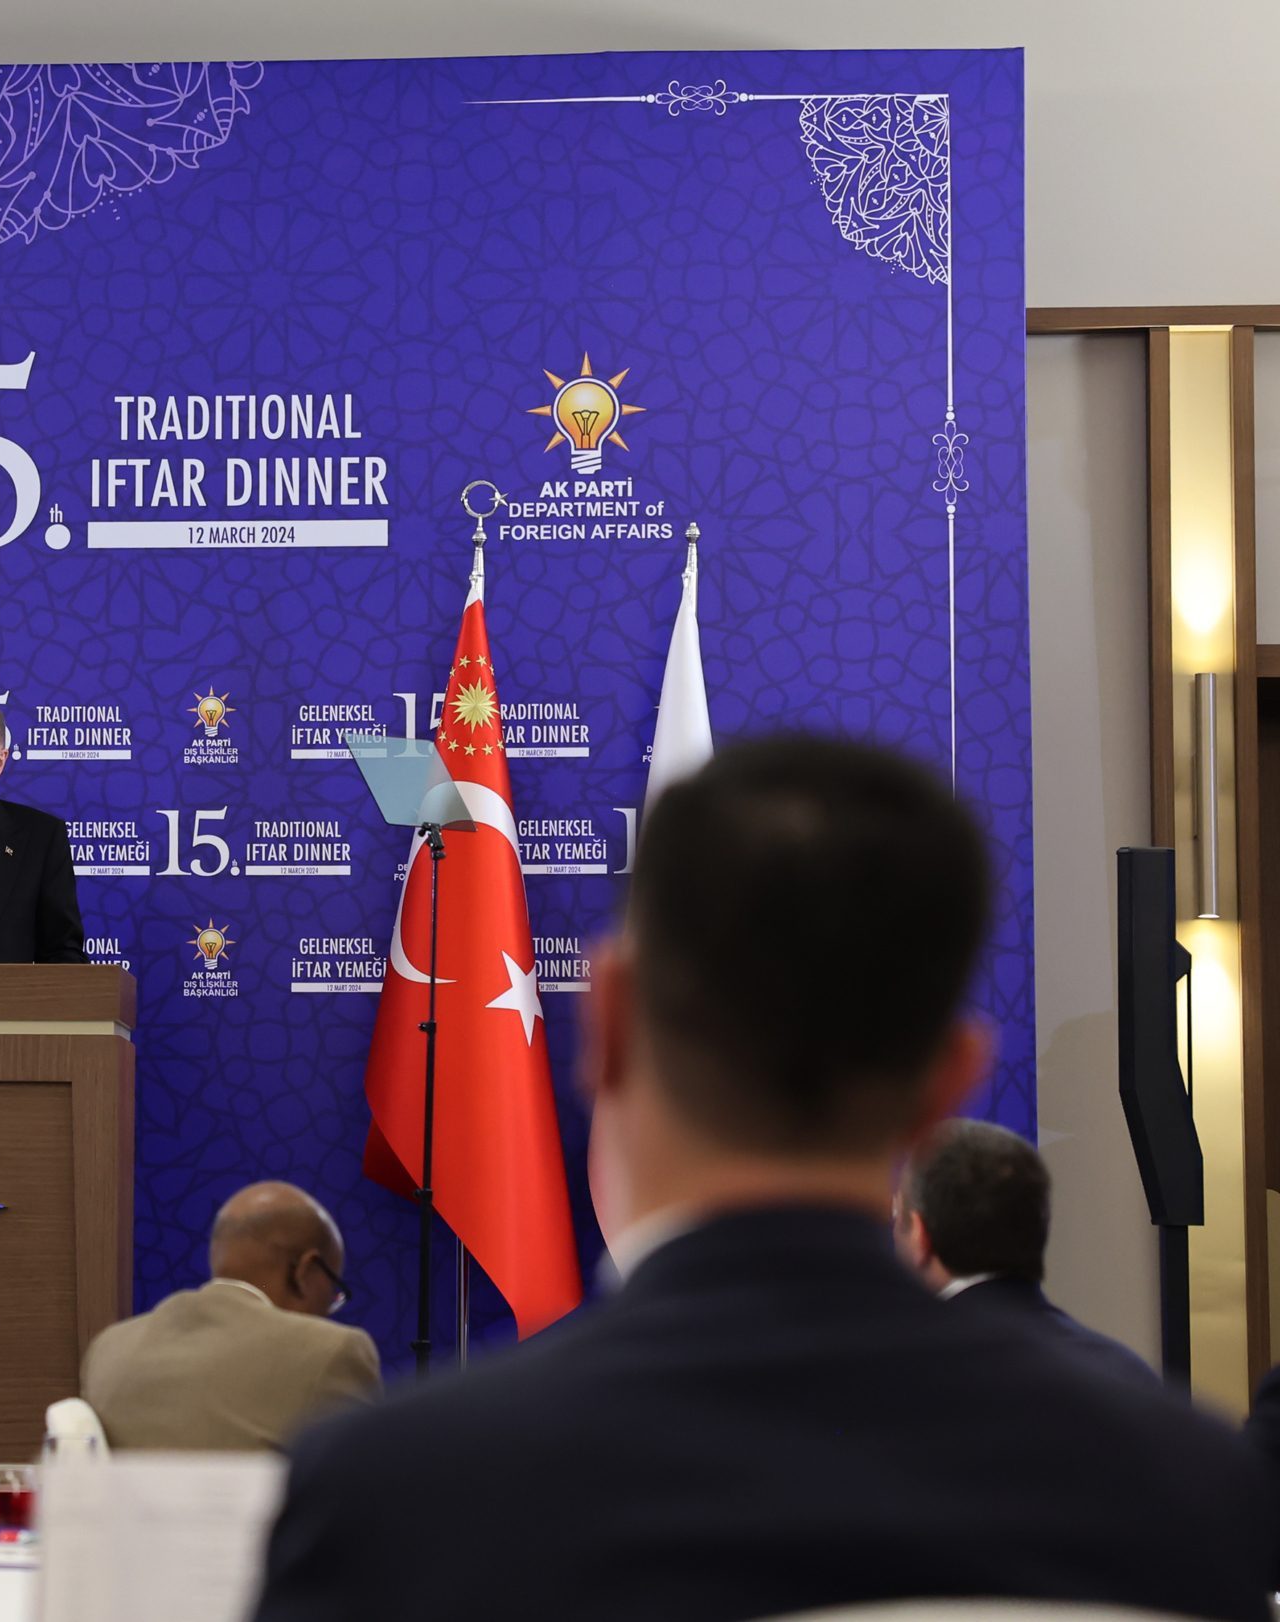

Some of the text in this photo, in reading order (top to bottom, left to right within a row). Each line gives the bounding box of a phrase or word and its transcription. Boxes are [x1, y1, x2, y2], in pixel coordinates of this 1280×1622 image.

[114, 394, 361, 440] TRADITIONAL
[91, 456, 389, 507] IFTAR DINNER
[540, 477, 633, 498] AK PARTİ
[49, 503, 63, 523] th
[509, 501, 664, 518] DEPARTMENT of
[188, 526, 296, 544] 12 MARCH 2024
[499, 523, 673, 541] FOREIGN AFFAIRS
[36, 705, 122, 723] TRADITIONAL
[299, 705, 375, 721] GELENEKSEL
[500, 703, 580, 720] RADITIONAL
[27, 728, 132, 746] IFTAR DINNER
[192, 739, 204, 747] AK
[292, 725, 331, 745] İFTAR
[531, 725, 590, 743] DINNER
[254, 821, 341, 838] TRADITIONAL
[518, 820, 595, 836] GELENEKSEL
[155, 805, 240, 877] 15.
[555, 838, 607, 860] YEMEĞİ
[99, 840, 150, 861] YEMEĞİ
[246, 843, 351, 861] IFTAR DINNER
[299, 938, 376, 955] GELENEKSEL
[532, 937, 582, 954] TIONAL
[191, 972, 204, 980] AK
[292, 957, 387, 978] İFTAR YEMEĞİ
